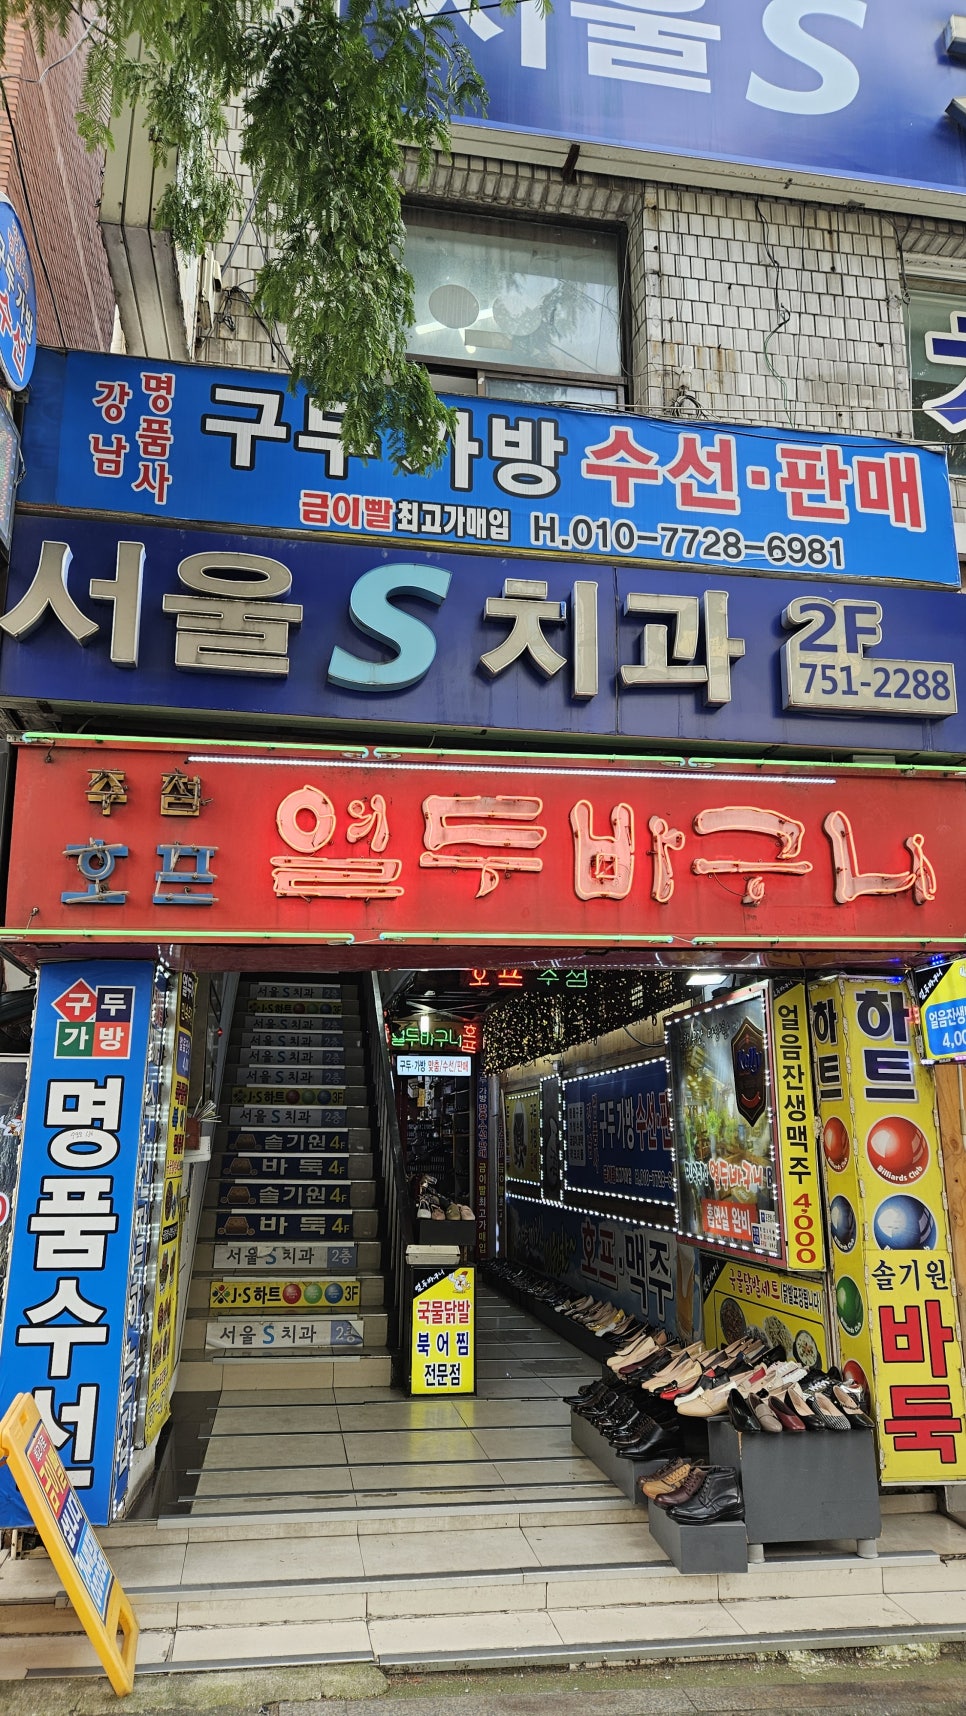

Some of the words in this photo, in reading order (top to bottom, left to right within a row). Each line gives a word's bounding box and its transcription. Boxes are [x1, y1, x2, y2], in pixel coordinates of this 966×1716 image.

[91, 381, 132, 478] 강남
[133, 372, 174, 505] 명품사
[300, 489, 393, 531] 금이빨
[799, 602, 878, 654] 2F
[800, 663, 951, 701] 751-2288
[269, 784, 937, 905] 열두바구니
[60, 838, 219, 905] 호프
[65, 993, 127, 1016] 구두
[929, 1005, 966, 1029] 얼음잔생
[62, 1026, 124, 1050] 가방
[813, 997, 843, 1102] 하트
[854, 990, 919, 1104] 하트
[778, 1004, 811, 1184] 얼음잔생맥주
[265, 1134, 326, 1151] 솔기원
[709, 1158, 763, 1192] 열두바구니
[877, 1165, 908, 1181] Billiards
[908, 1166, 922, 1179] Club
[260, 1186, 326, 1204] 솔기원
[330, 1188, 347, 1202] 4F
[332, 1218, 350, 1233] 4F
[707, 1204, 730, 1231] 흡연실
[731, 1207, 751, 1236] 완비
[793, 1193, 816, 1264] 4,000
[332, 1249, 352, 1264] 2층
[15, 1076, 124, 1489] 명품수선
[415, 1268, 446, 1293] 열두바구니
[871, 1259, 949, 1292] 솔기원
[344, 1286, 358, 1300] 3F
[417, 1300, 470, 1325] 국물닭발
[417, 1331, 469, 1357] 북어찜
[424, 1363, 461, 1387] 전문점
[878, 1299, 962, 1464] 바둑
